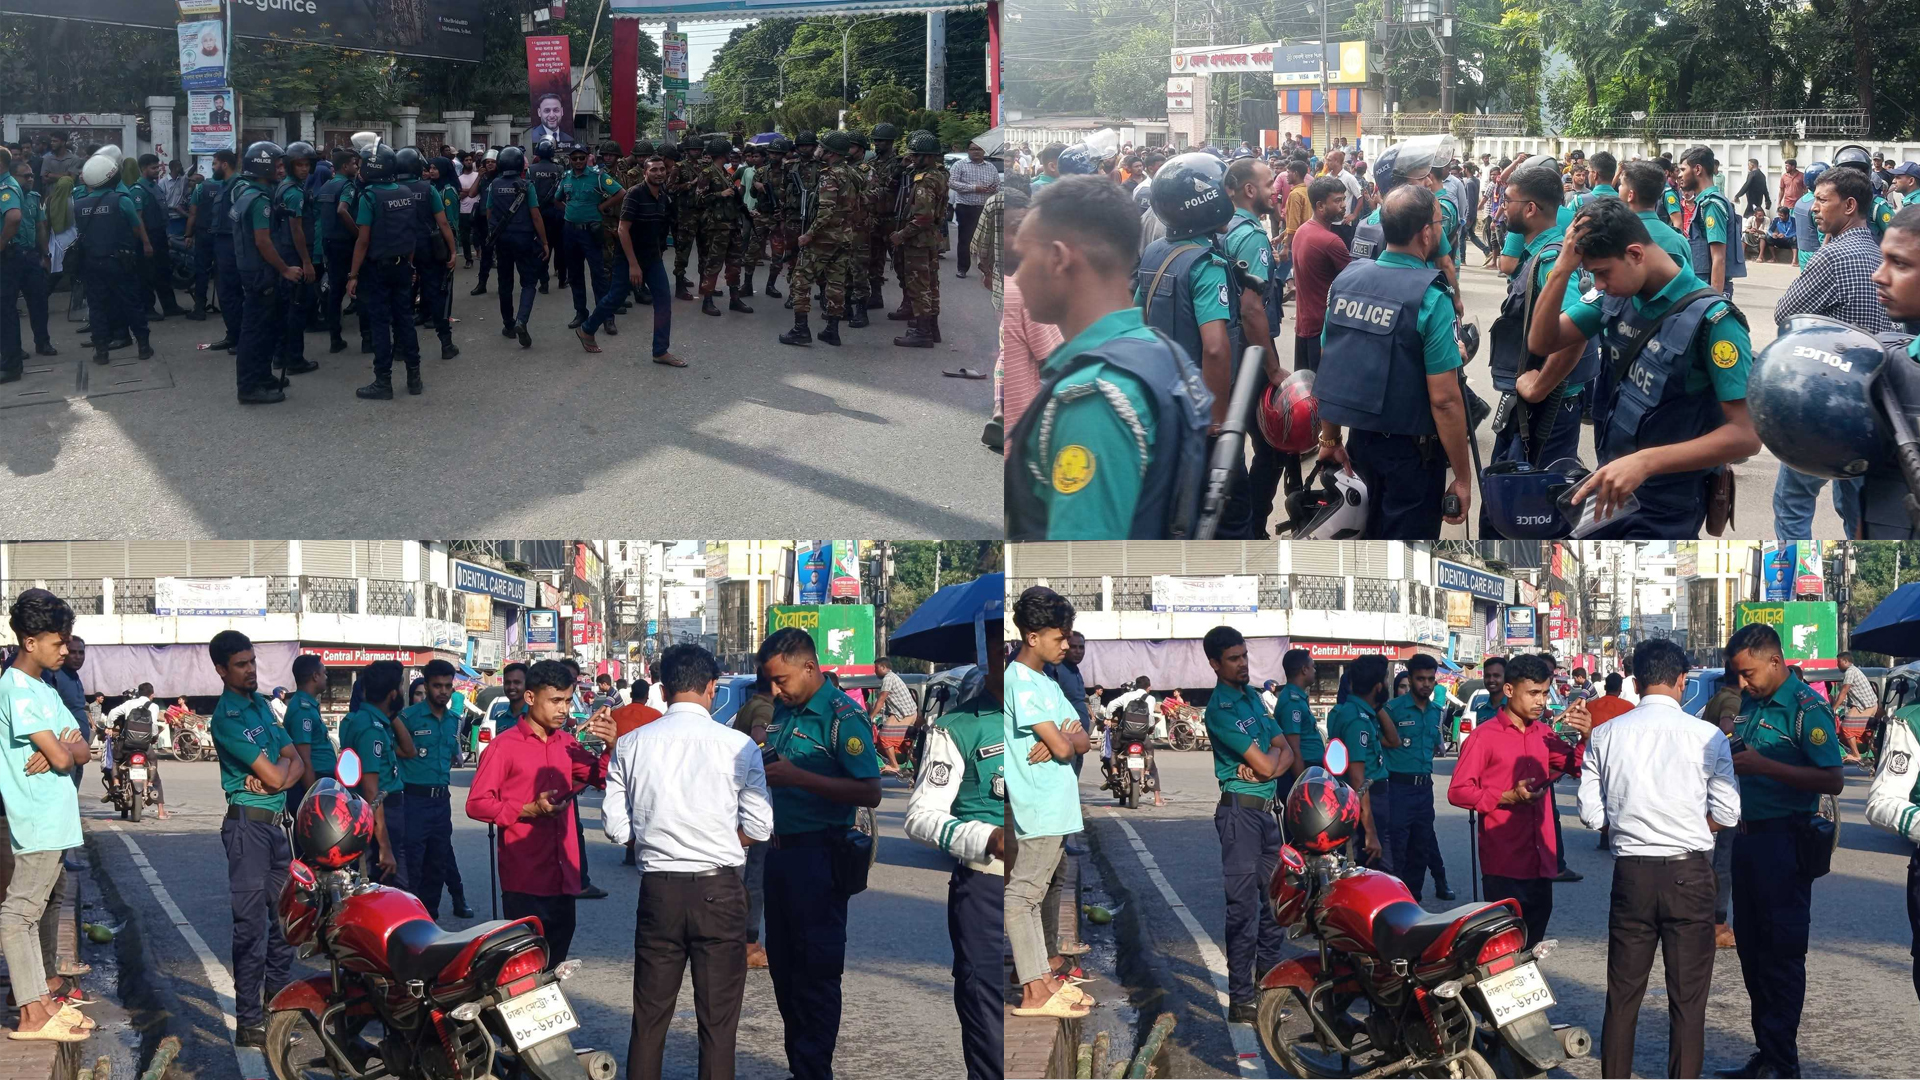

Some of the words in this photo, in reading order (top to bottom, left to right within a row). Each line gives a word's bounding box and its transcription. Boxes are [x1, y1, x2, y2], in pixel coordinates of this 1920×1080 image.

[1190, 54, 1208, 67] জেলা
[1210, 52, 1247, 67] প্রশাসকের
[1376, 163, 1391, 175] POLICE
[388, 198, 412, 209] POLICE
[1184, 189, 1219, 209] POLICE
[1333, 298, 1395, 328] POLICE
[1792, 345, 1854, 373] POLICE
[1610, 345, 1655, 396] PLICE
[1516, 514, 1552, 525] POLICE
[462, 568, 489, 592] DENTAL
[489, 576, 507, 597] CARE
[507, 580, 523, 600] PLUS
[1444, 567, 1470, 589] DENTAL
[1470, 574, 1487, 594] CARE
[1487, 578, 1503, 597] PLUS
[323, 650, 353, 661] Central
[355, 650, 395, 661] Pharmacy
[396, 651, 412, 661] Ltd.
[1311, 645, 1341, 655] Central
[1342, 645, 1380, 655] Pharmacy
[1381, 645, 1397, 655] Ltd.
[1485, 985, 1505, 997] ঢাকা
[1494, 988, 1548, 1017] ৩৮-৬৮০০
[506, 1006, 525, 1019] ঢাকা
[514, 1011, 571, 1041] ৩৮-৬৮০০
